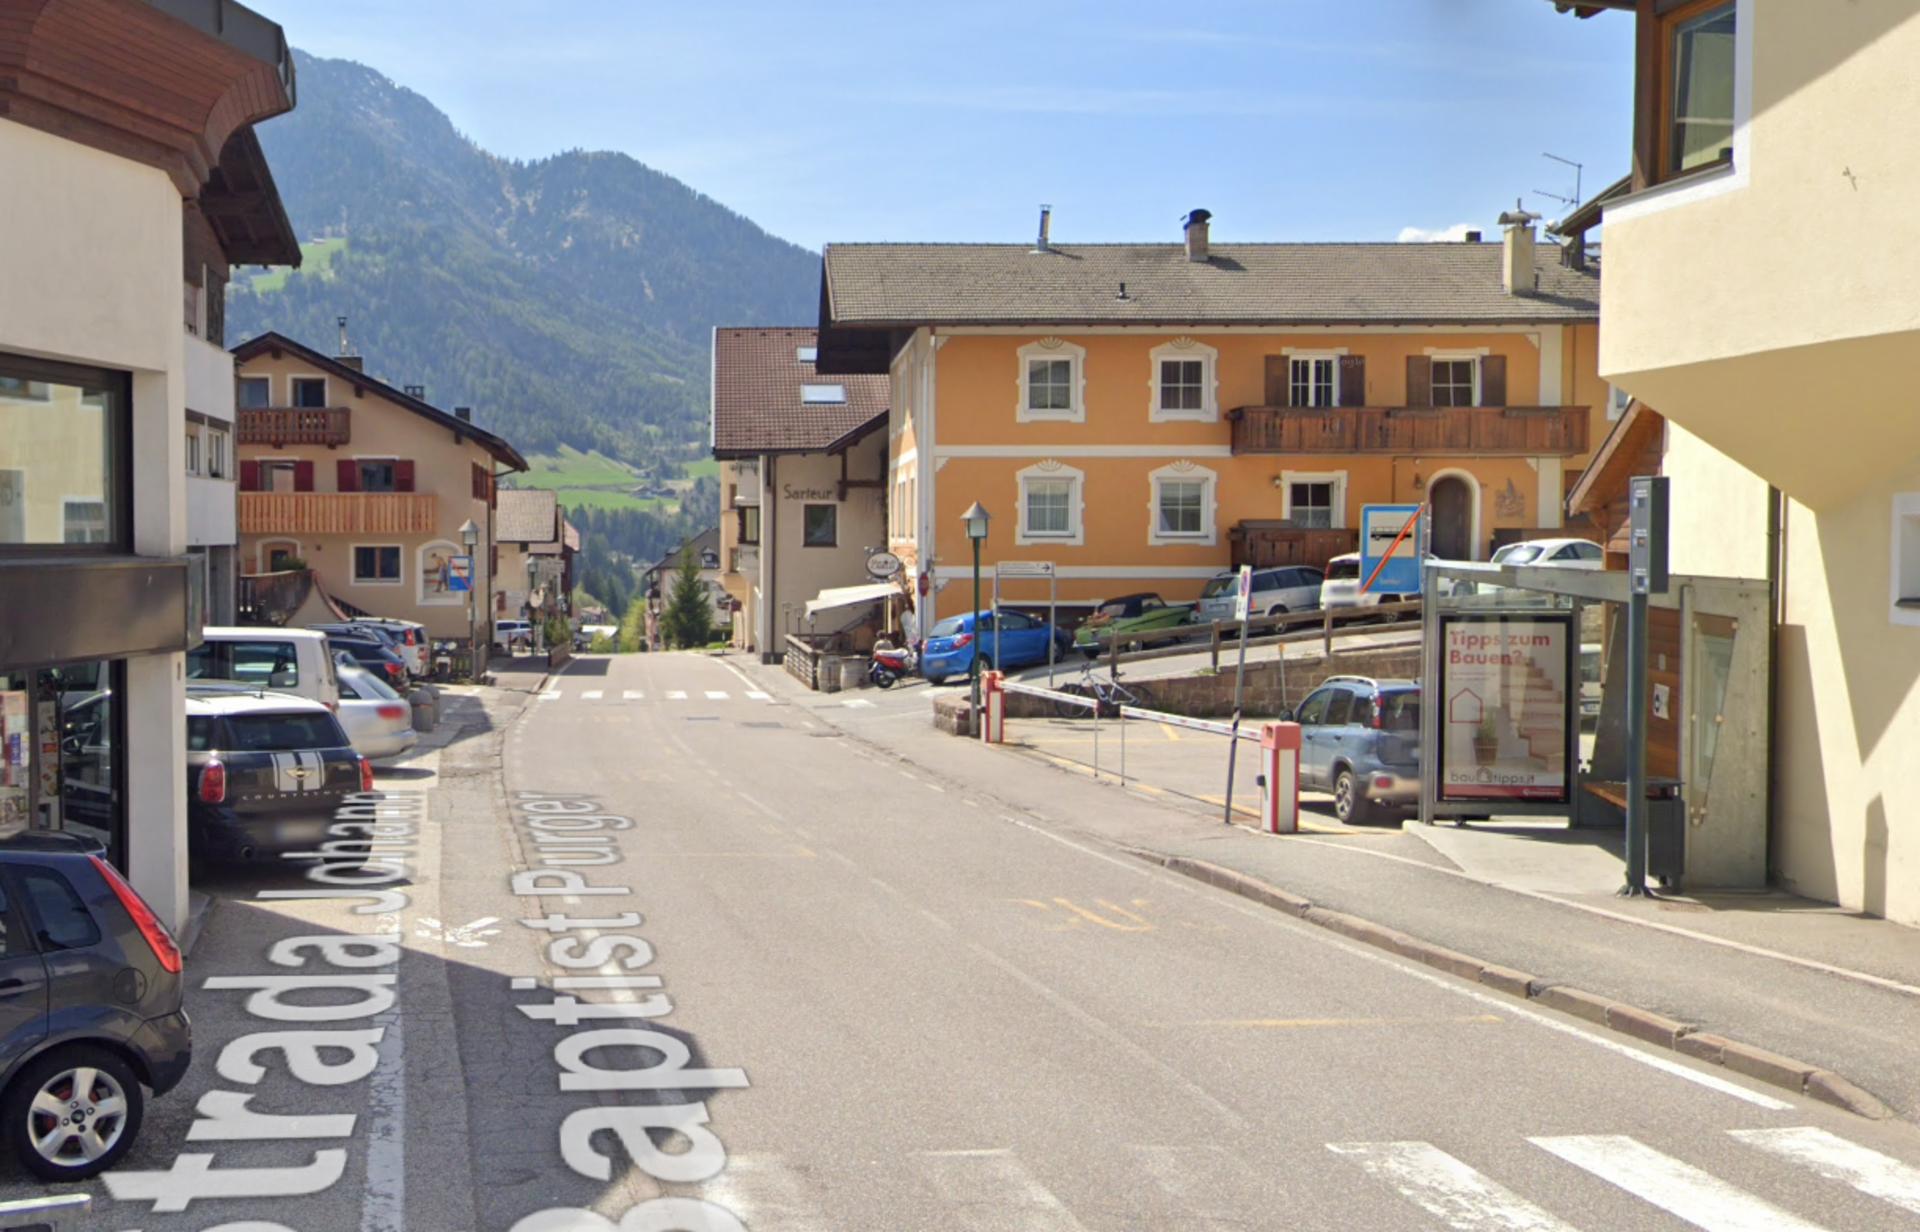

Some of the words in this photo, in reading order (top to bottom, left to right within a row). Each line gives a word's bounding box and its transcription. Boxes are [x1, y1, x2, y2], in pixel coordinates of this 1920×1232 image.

[1450, 630, 1501, 650] Tipps
[1508, 634, 1552, 647] zum
[1449, 650, 1523, 665] Bauen?
